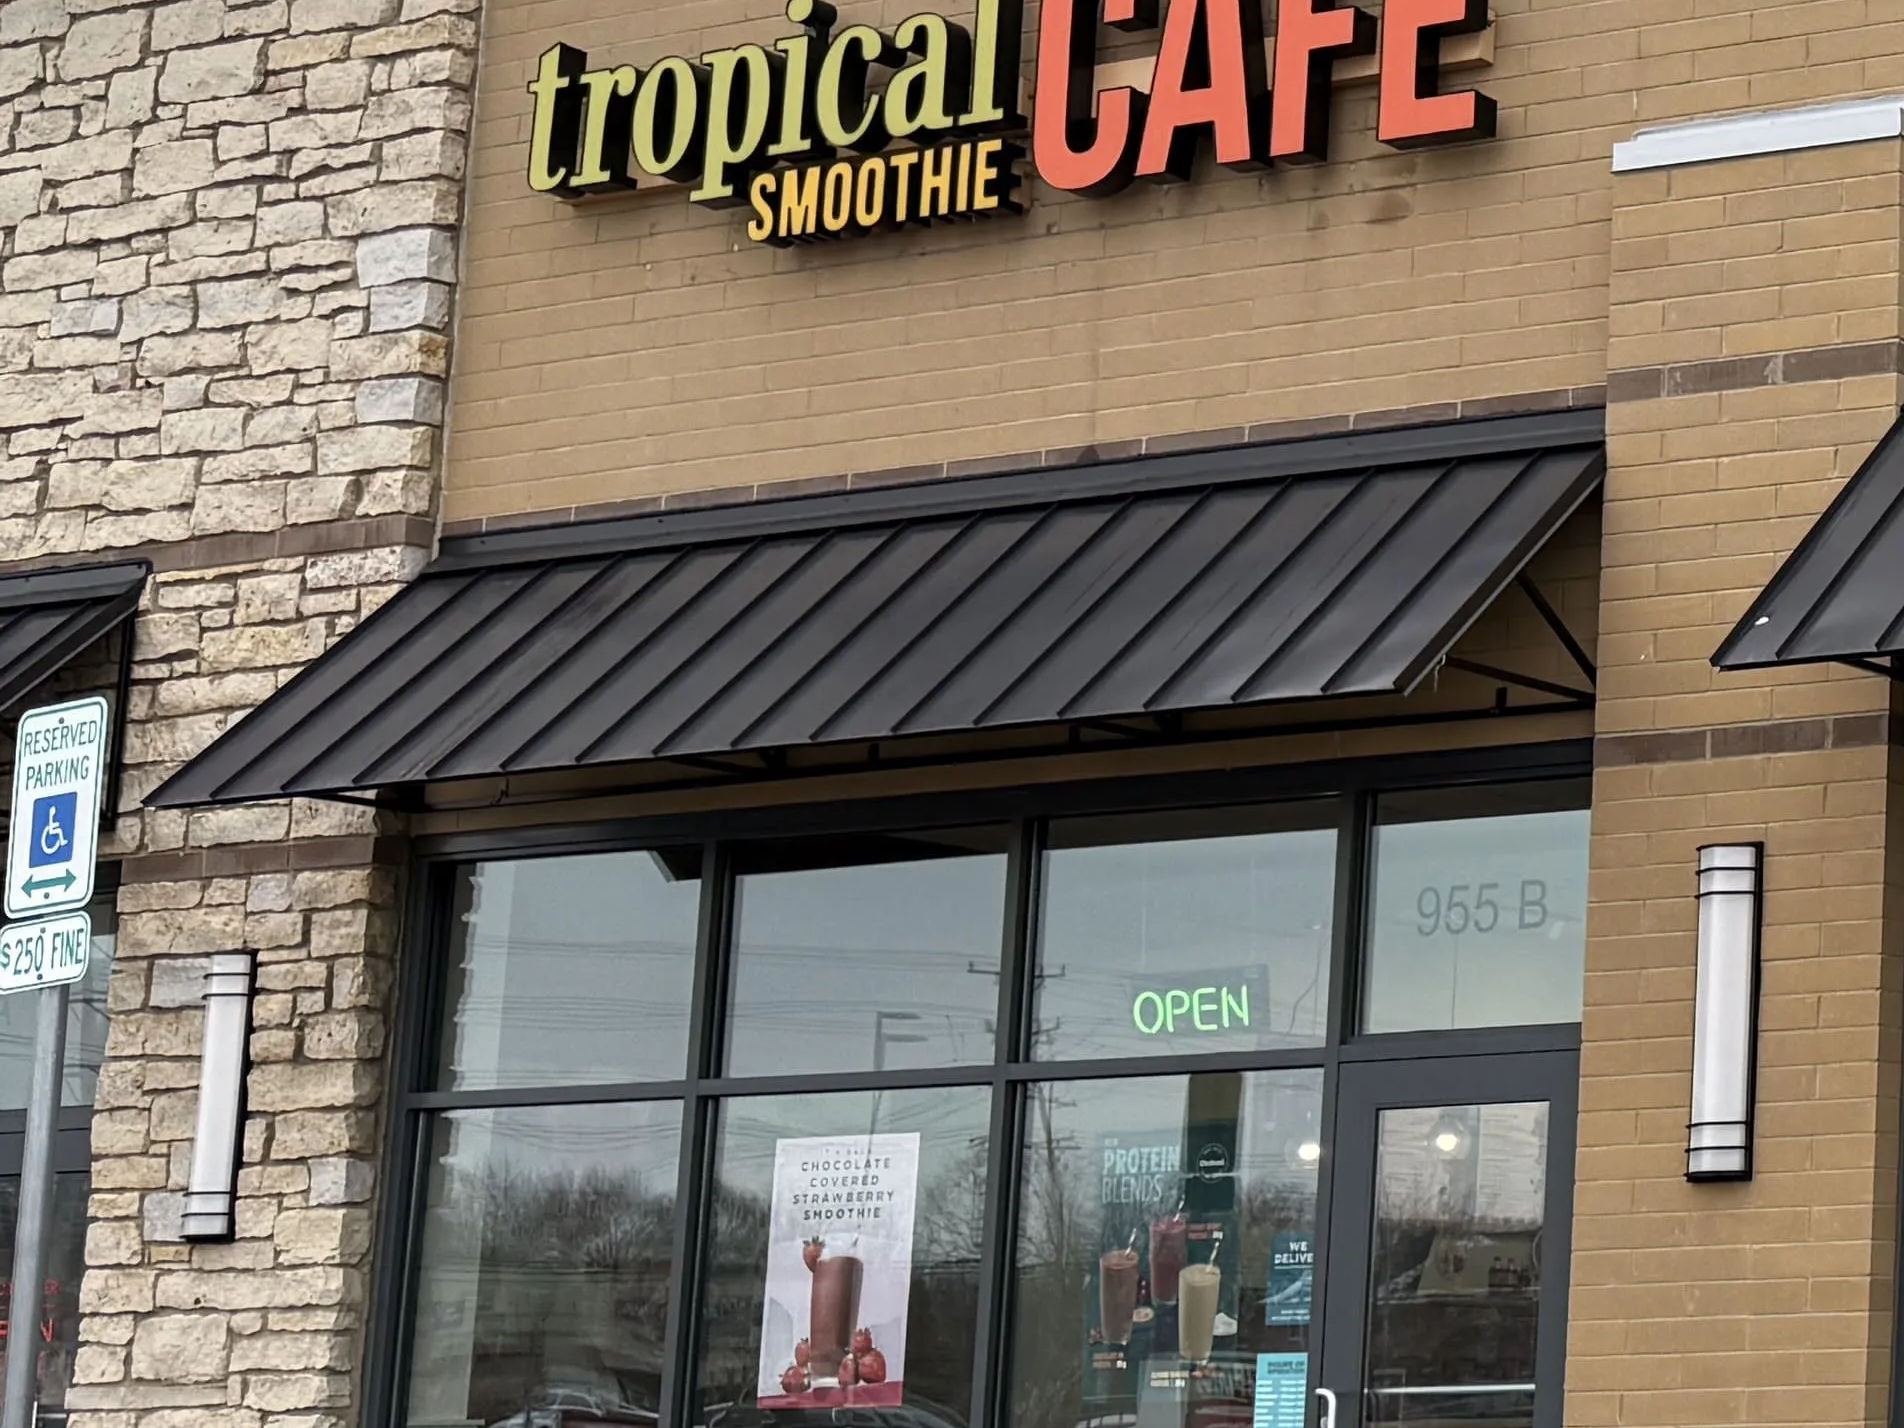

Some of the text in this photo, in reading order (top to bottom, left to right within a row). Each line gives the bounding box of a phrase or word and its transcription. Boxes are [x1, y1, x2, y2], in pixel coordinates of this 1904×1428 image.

[747, 137, 1004, 244] SMOOTHIE
[24, 720, 98, 757] RESERVED
[26, 755, 90, 791] PARKING
[1416, 879, 1548, 936] 955 B
[0, 928, 84, 976] $250 FINE
[1133, 984, 1249, 1034] OPEN
[801, 1158, 891, 1172] CHOCOLATE
[1103, 1146, 1180, 1174] PROTEIN
[810, 1175, 879, 1187] COVERED
[1103, 1174, 1164, 1204] BLENDS
[793, 1191, 894, 1205] STRAWBERRY
[804, 1207, 881, 1220] SMOOTHIE
[1289, 1241, 1308, 1251] WE
